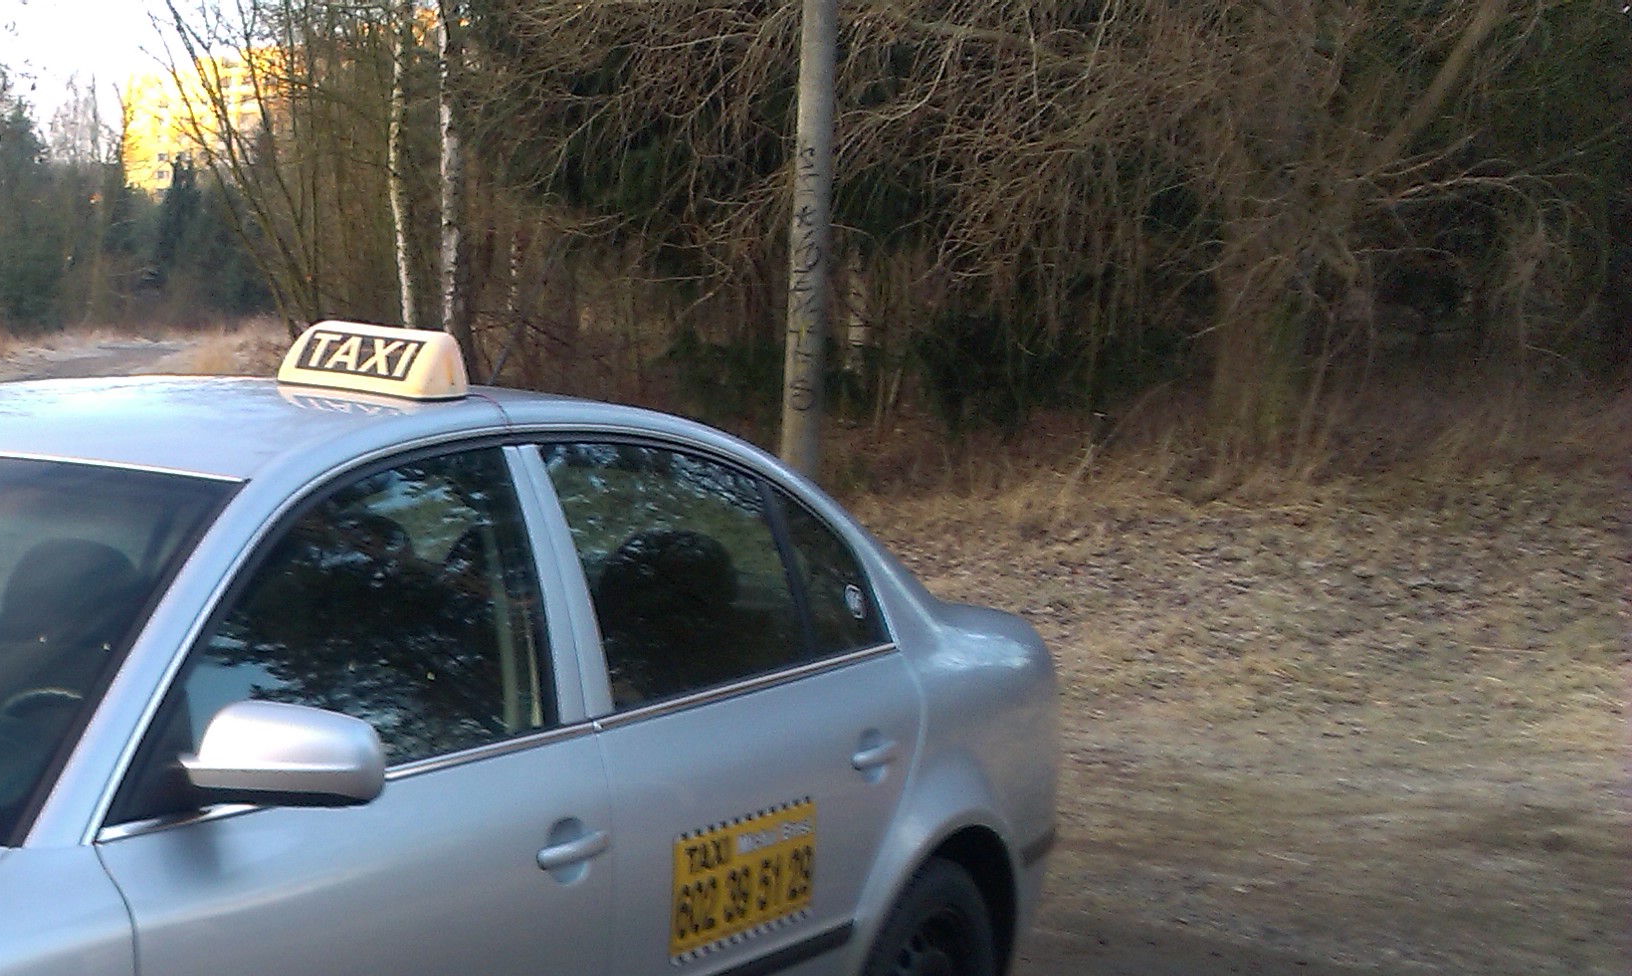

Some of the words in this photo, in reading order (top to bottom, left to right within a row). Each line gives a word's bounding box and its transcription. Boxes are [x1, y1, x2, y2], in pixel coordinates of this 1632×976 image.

[308, 332, 418, 377] TAXI
[684, 836, 730, 874] TAXI
[676, 875, 717, 938] 602
[756, 853, 780, 912] 51
[786, 845, 813, 899] 29
